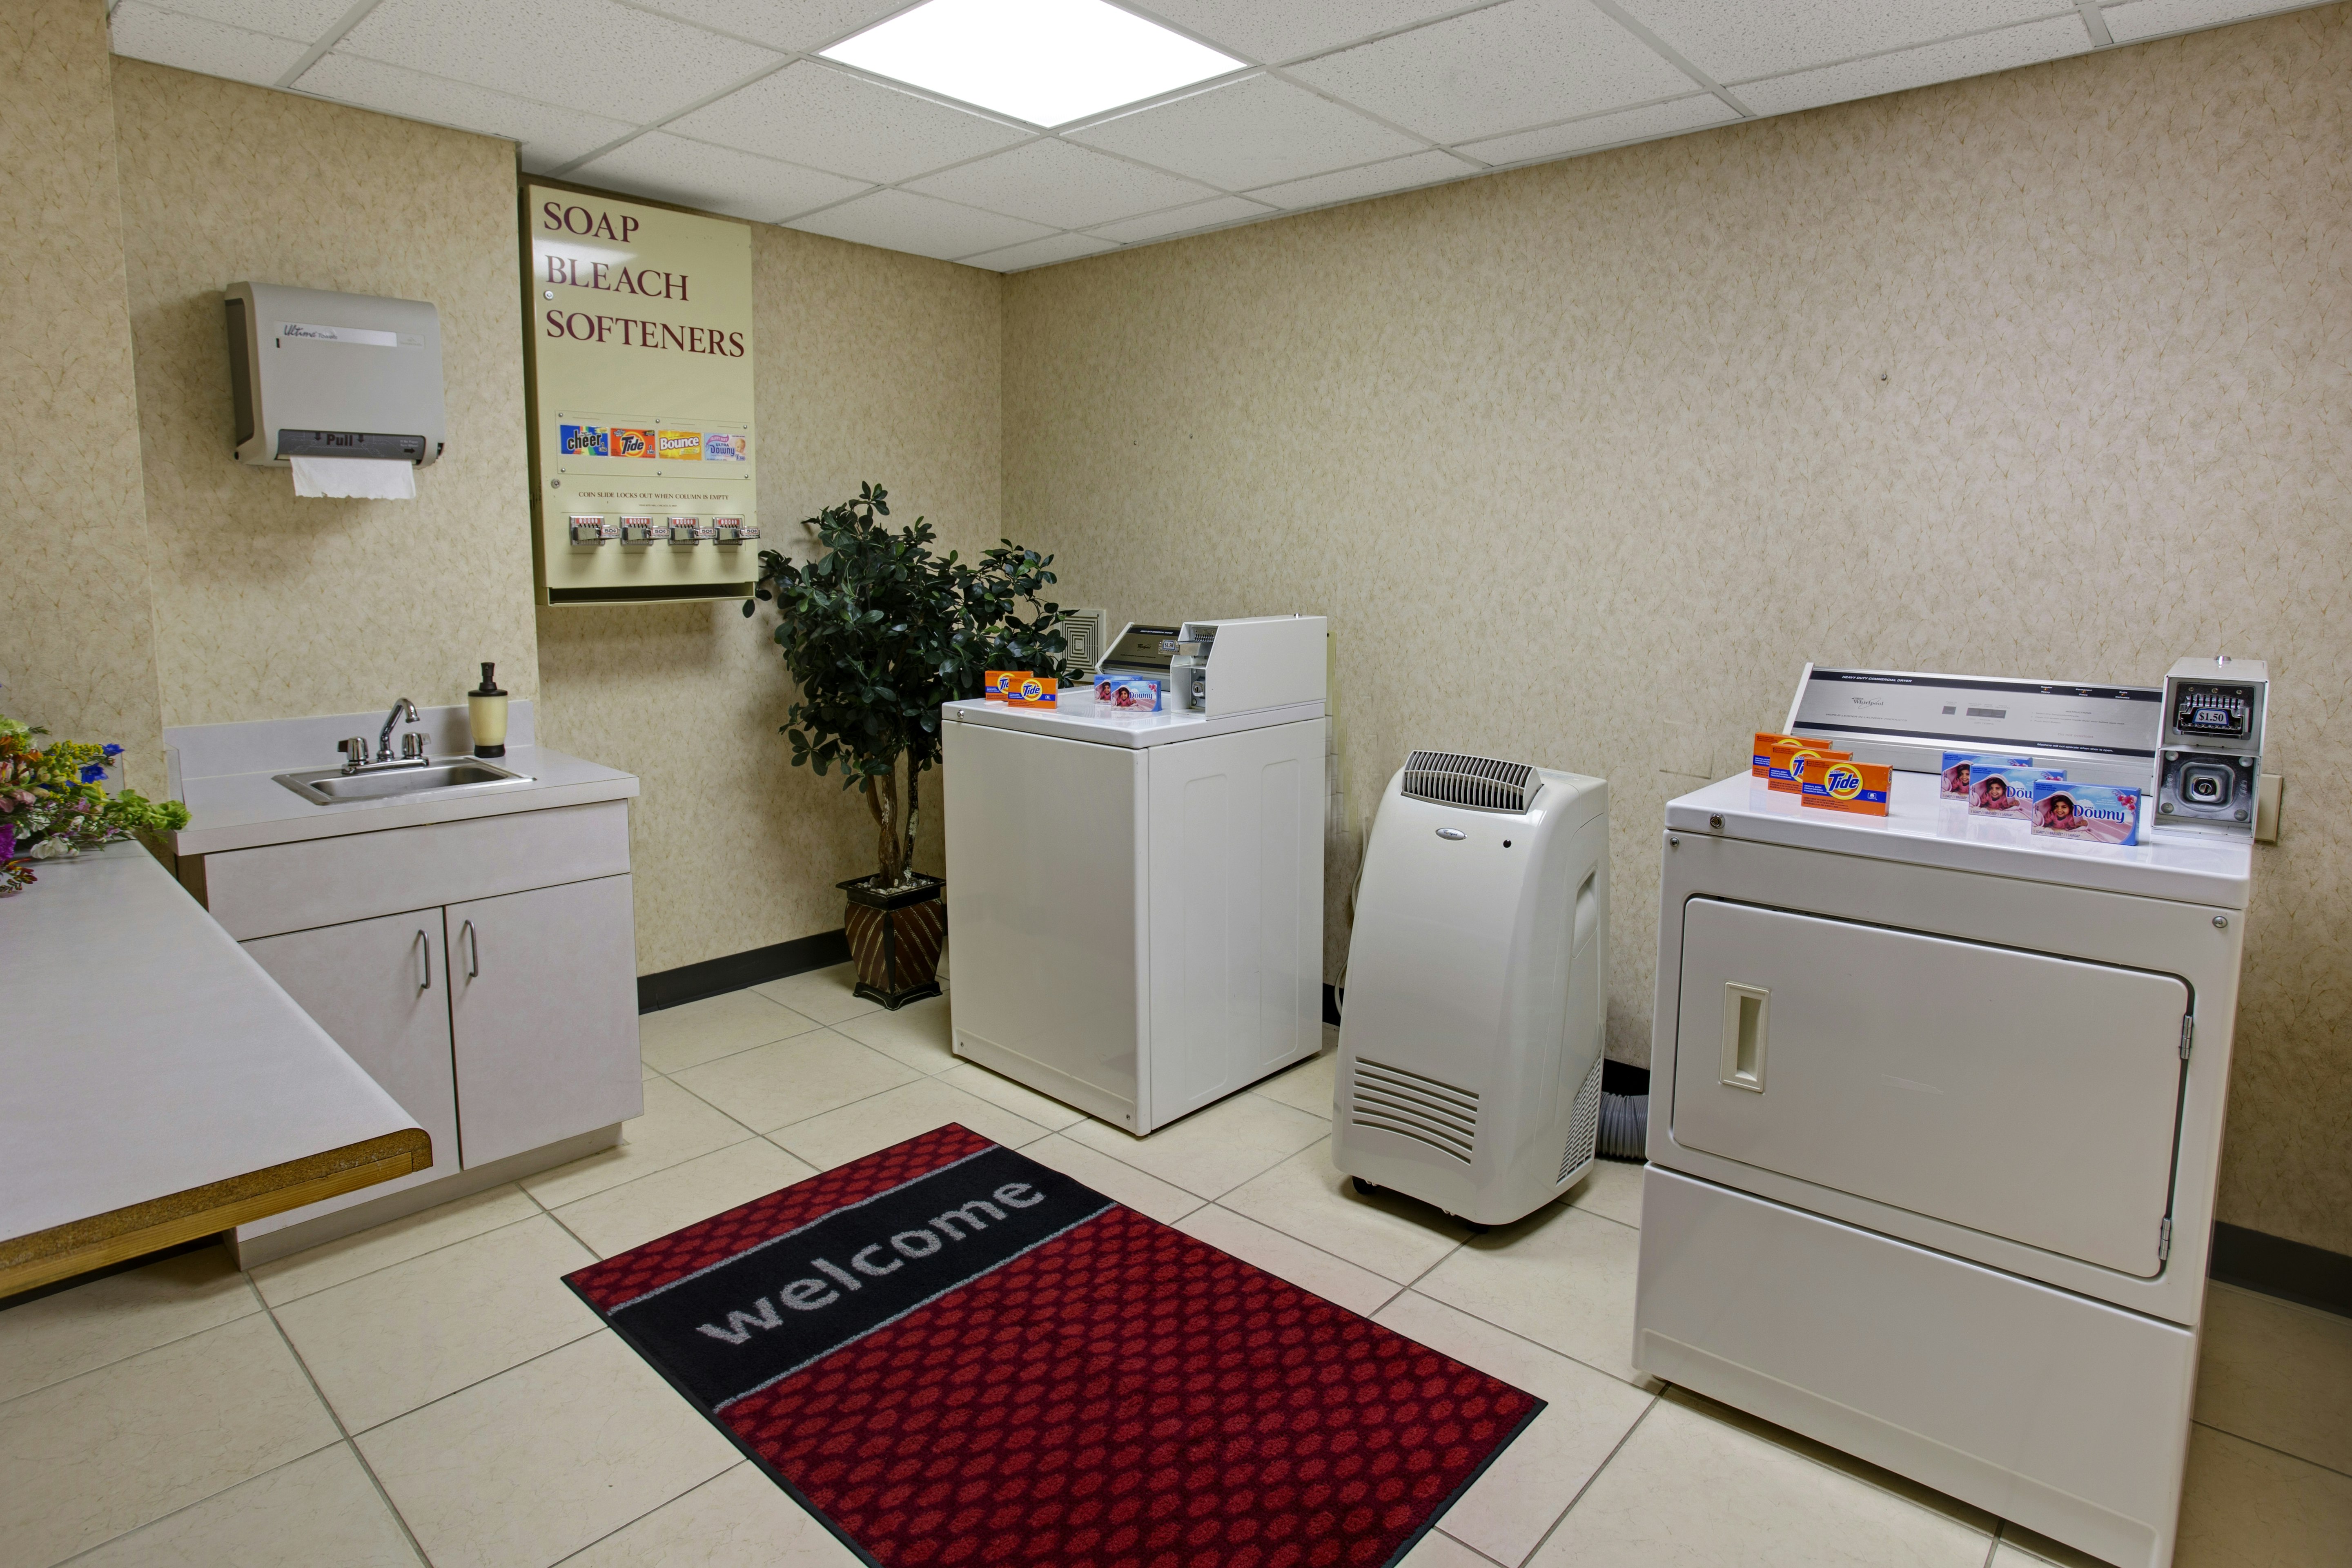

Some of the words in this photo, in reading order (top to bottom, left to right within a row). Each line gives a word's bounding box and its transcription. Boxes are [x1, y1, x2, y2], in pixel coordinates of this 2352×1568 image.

[543, 202, 639, 243] SOAP
[545, 255, 689, 301] BLEACH
[546, 310, 744, 357] SOFTENERS
[327, 434, 353, 446] Pull
[568, 430, 601, 450] cheer
[621, 436, 644, 455] Tide
[659, 437, 699, 450] Bounce
[710, 445, 735, 457] Downy
[1000, 679, 1009, 690] Ti
[1023, 684, 1040, 697] Tide
[2198, 712, 2224, 722] $1.50
[1793, 760, 1804, 776] Ti
[1829, 773, 1859, 792] Tide
[2074, 805, 2125, 824] Downy
[695, 1181, 1046, 1345] welcome
